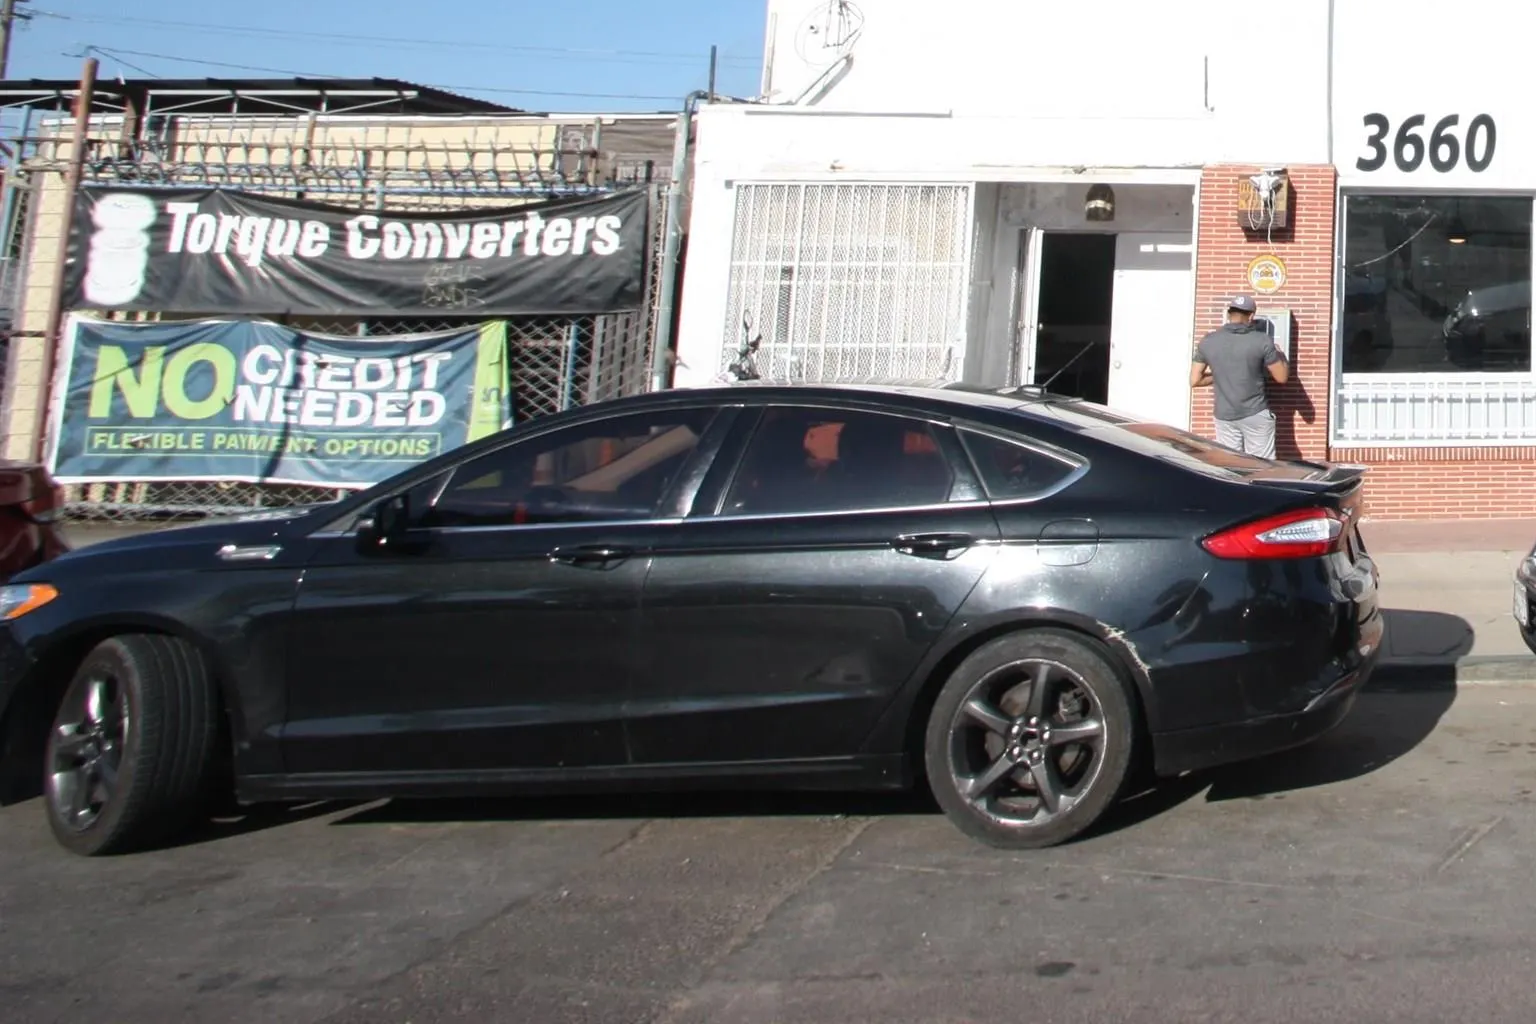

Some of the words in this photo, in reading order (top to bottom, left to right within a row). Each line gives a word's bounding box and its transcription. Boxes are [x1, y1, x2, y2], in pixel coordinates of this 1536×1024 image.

[1355, 112, 1497, 173] 3660
[165, 202, 331, 266] Torque
[345, 211, 622, 259] Converters
[88, 342, 236, 419] NO
[241, 344, 452, 390] CREDIT
[232, 384, 447, 427] NEEDED
[212, 433, 317, 453] PAYMENT
[324, 438, 432, 456] OPTIONS
